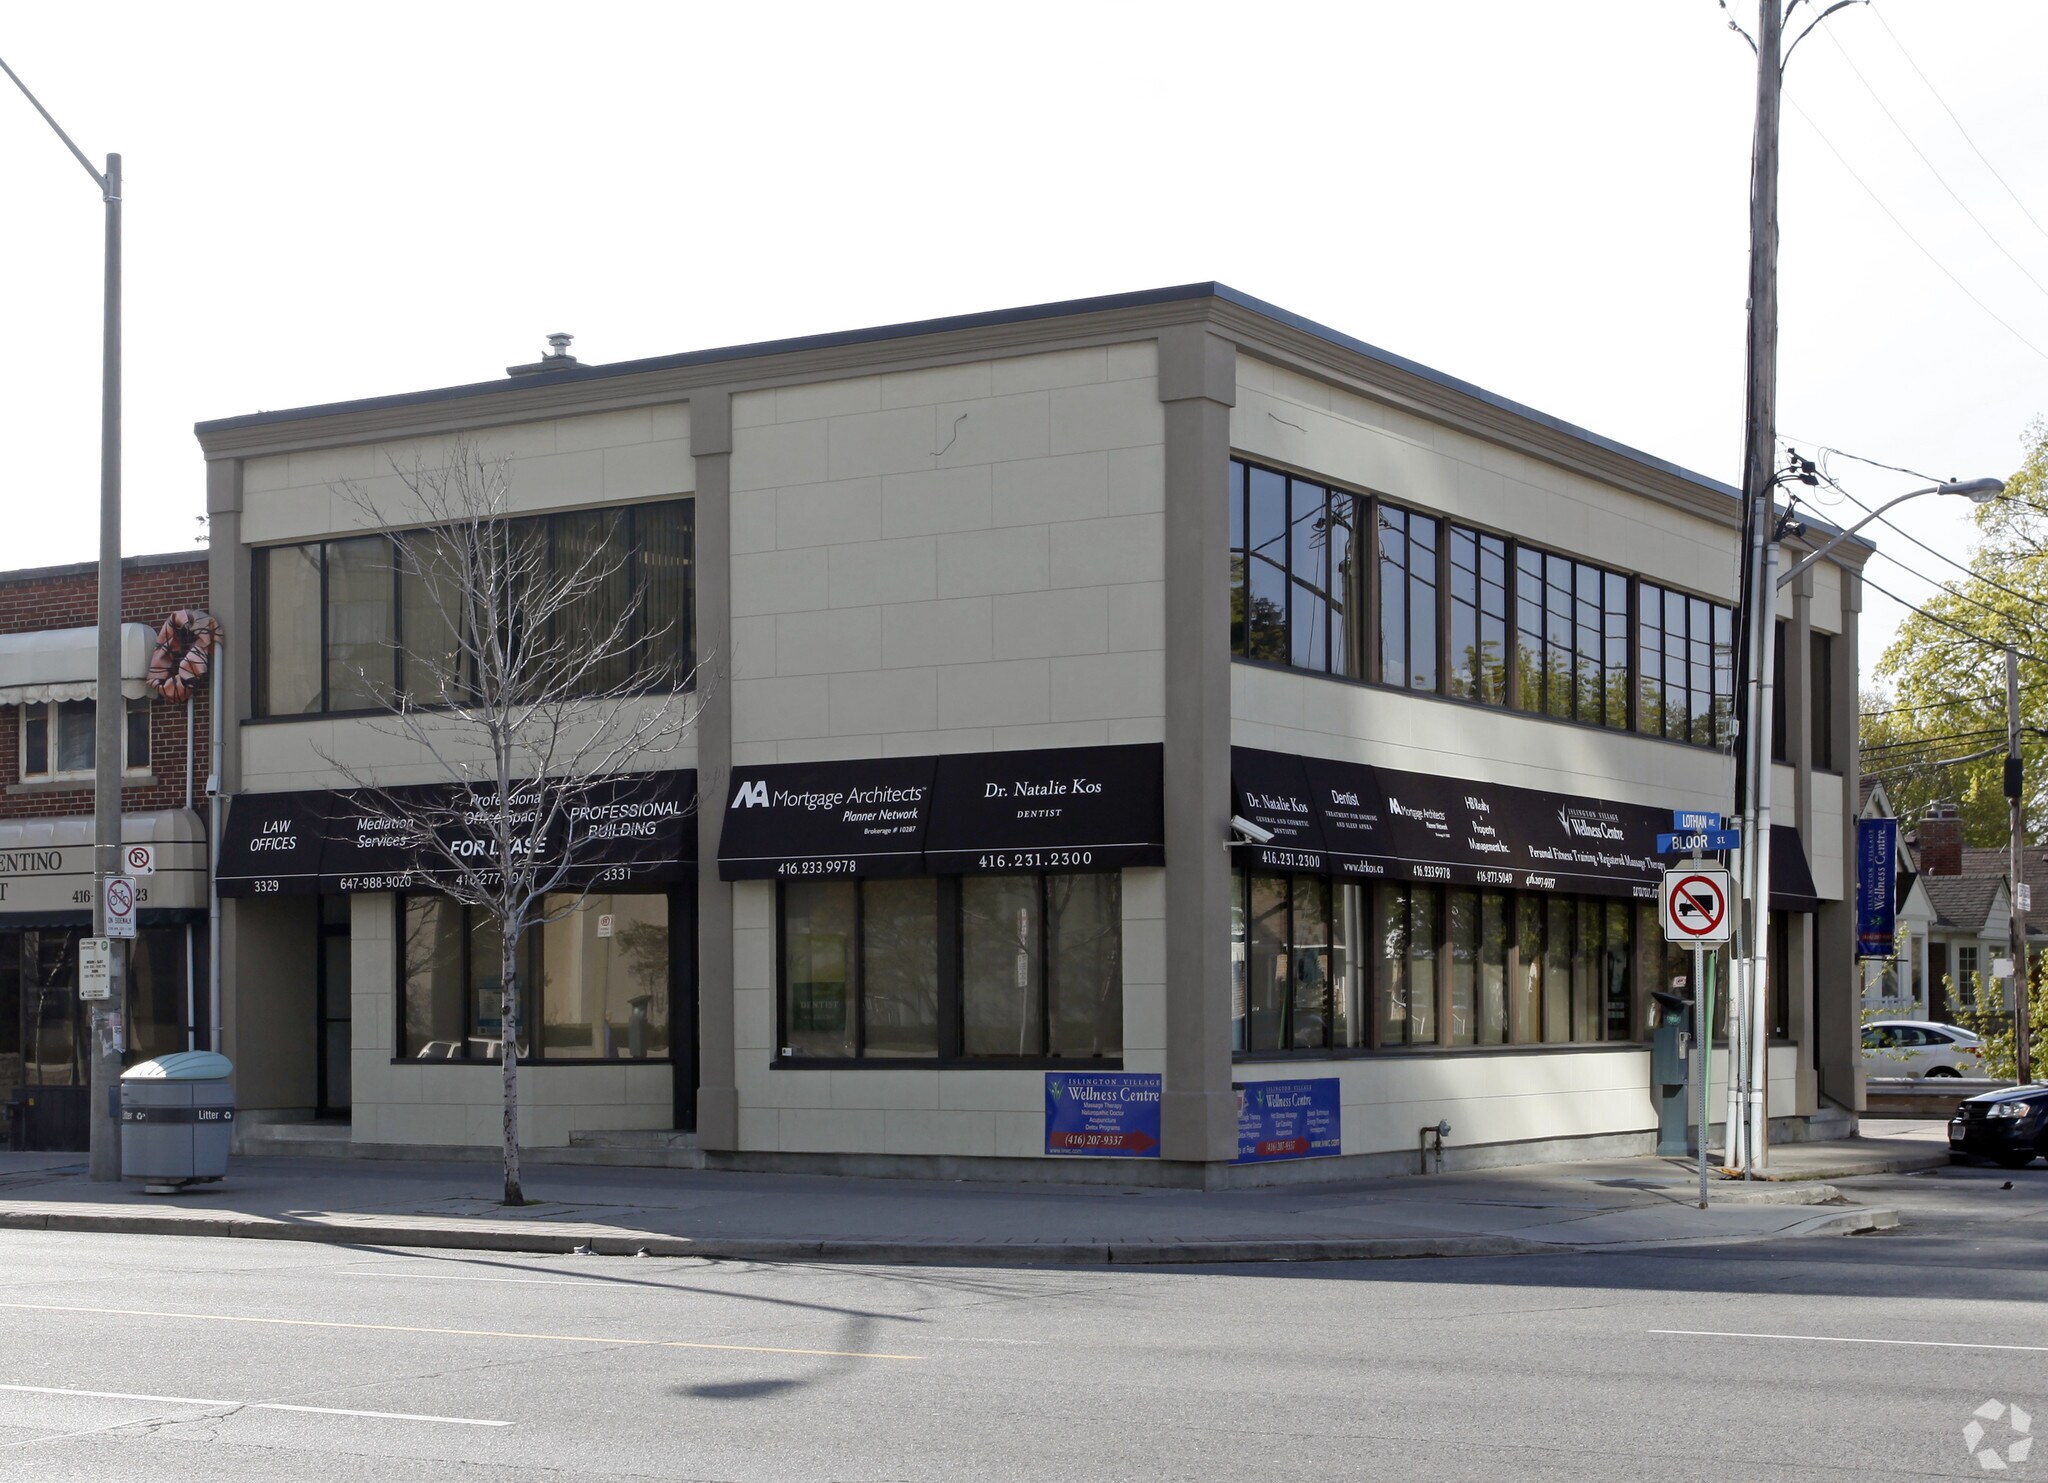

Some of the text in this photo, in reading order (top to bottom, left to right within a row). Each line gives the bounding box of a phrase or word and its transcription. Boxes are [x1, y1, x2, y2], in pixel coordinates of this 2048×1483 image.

[984, 779, 1102, 797] Dr. Natalie Kos
[470, 793, 542, 808] Profesiona
[773, 790, 843, 810] Mortgage
[1246, 792, 1308, 813] Dr. Natalie Kos
[1331, 790, 1360, 806] Dentist
[570, 801, 682, 821] PROFESSIONAL
[843, 807, 918, 822] Planner Network
[1017, 809, 1062, 818] DENTIST
[1401, 806, 1423, 820] Mortgage
[1423, 808, 1446, 820] Architects
[262, 820, 291, 834] LAW
[357, 815, 414, 831] Mediation
[1471, 820, 1496, 837] Property
[1570, 818, 1624, 840] Wellness Centre
[1682, 814, 1707, 829] LOTHIAN
[588, 821, 657, 838] BUILDING
[864, 827, 891, 835] Brokerage
[250, 836, 297, 851] OFFICES
[357, 834, 406, 848] Services
[451, 837, 547, 857] FOR LASE
[1672, 834, 1708, 850] BLOOR
[979, 852, 1092, 868] 416.231.2300
[1262, 850, 1320, 867] 416.231.2300
[603, 868, 631, 881] 3331
[778, 860, 856, 875] 416.233.9978
[1874, 829, 1886, 910] Wellness Centre
[254, 880, 279, 892] 3329
[340, 876, 412, 890] 647-988-9020
[1068, 1086, 1160, 1102] Wellness Centre
[199, 1110, 219, 1120] Litter
[1065, 1134, 1124, 1147] (416) 207-9337
